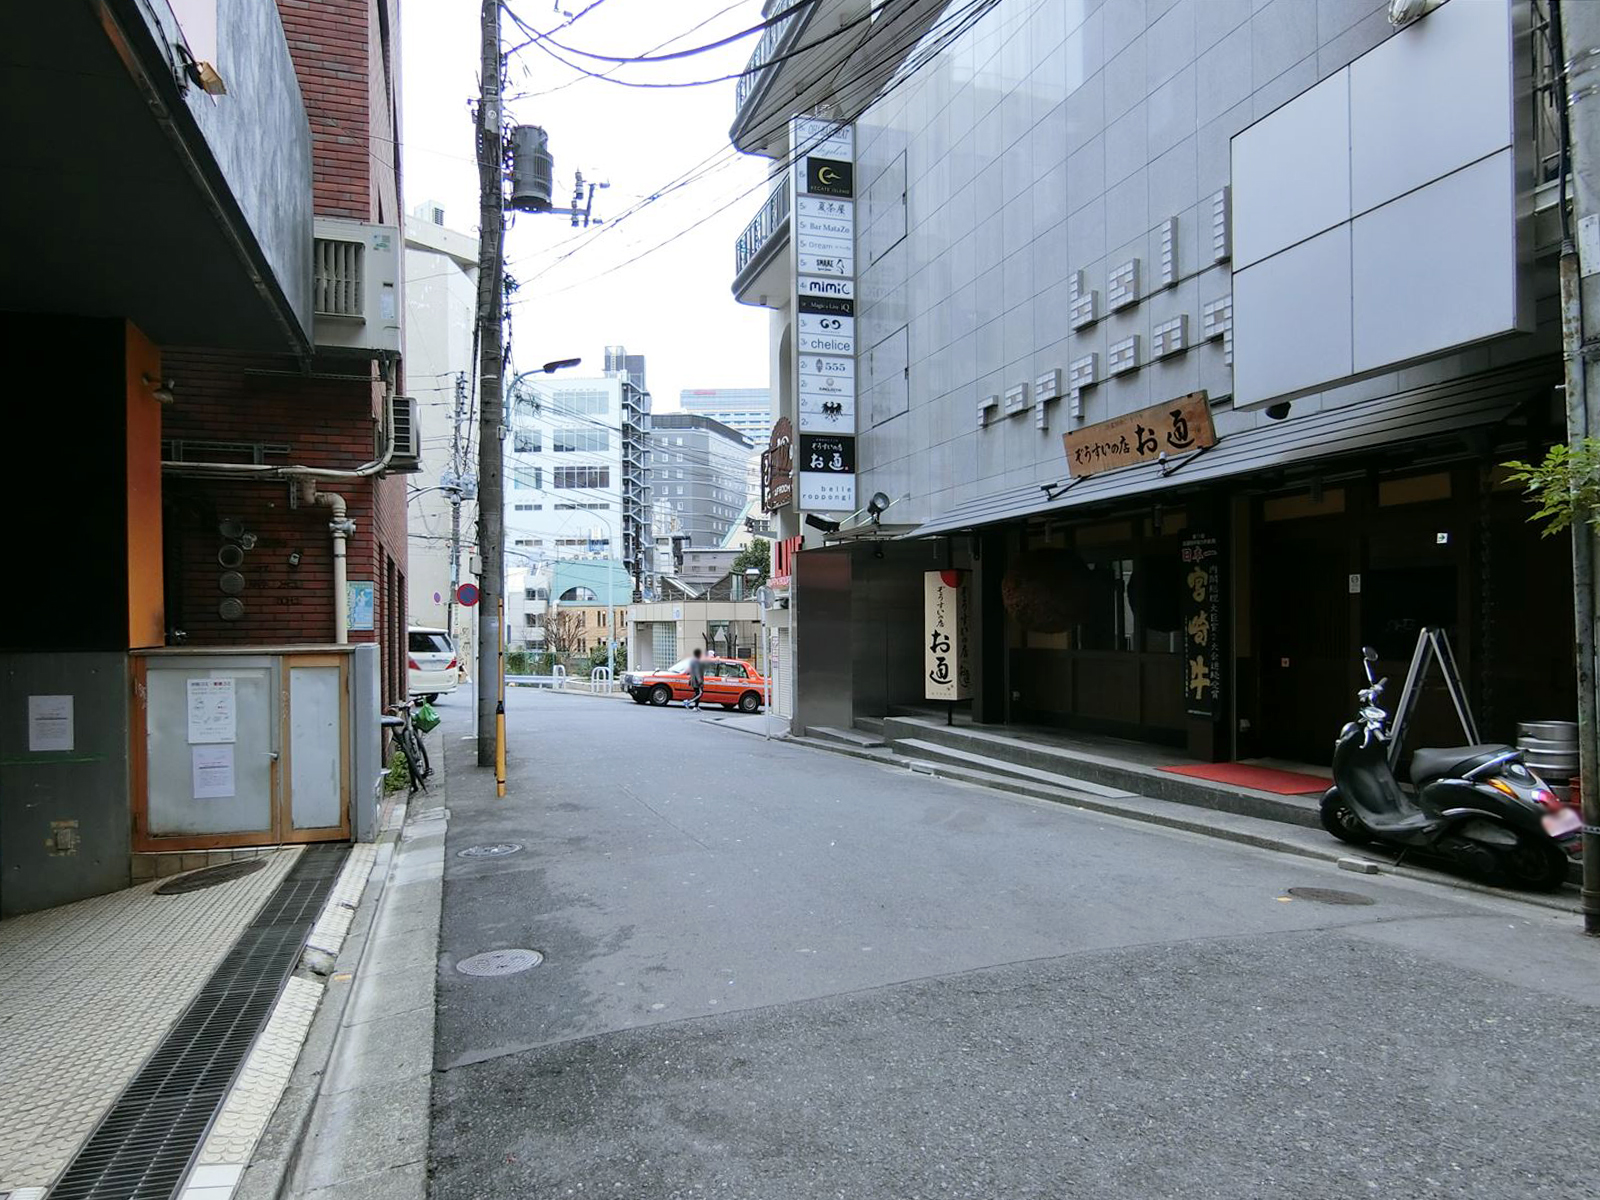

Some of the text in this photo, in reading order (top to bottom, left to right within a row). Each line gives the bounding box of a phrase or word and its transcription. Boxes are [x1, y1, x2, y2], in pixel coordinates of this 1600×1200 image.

[809, 241, 833, 250] Dream
[810, 338, 851, 352] chelice
[825, 362, 846, 372] 555
[1074, 435, 1131, 465] ぞうすいの店
[821, 485, 852, 493] belle
[802, 493, 851, 501] roppongi
[1187, 566, 1211, 700] 宮崎牛
